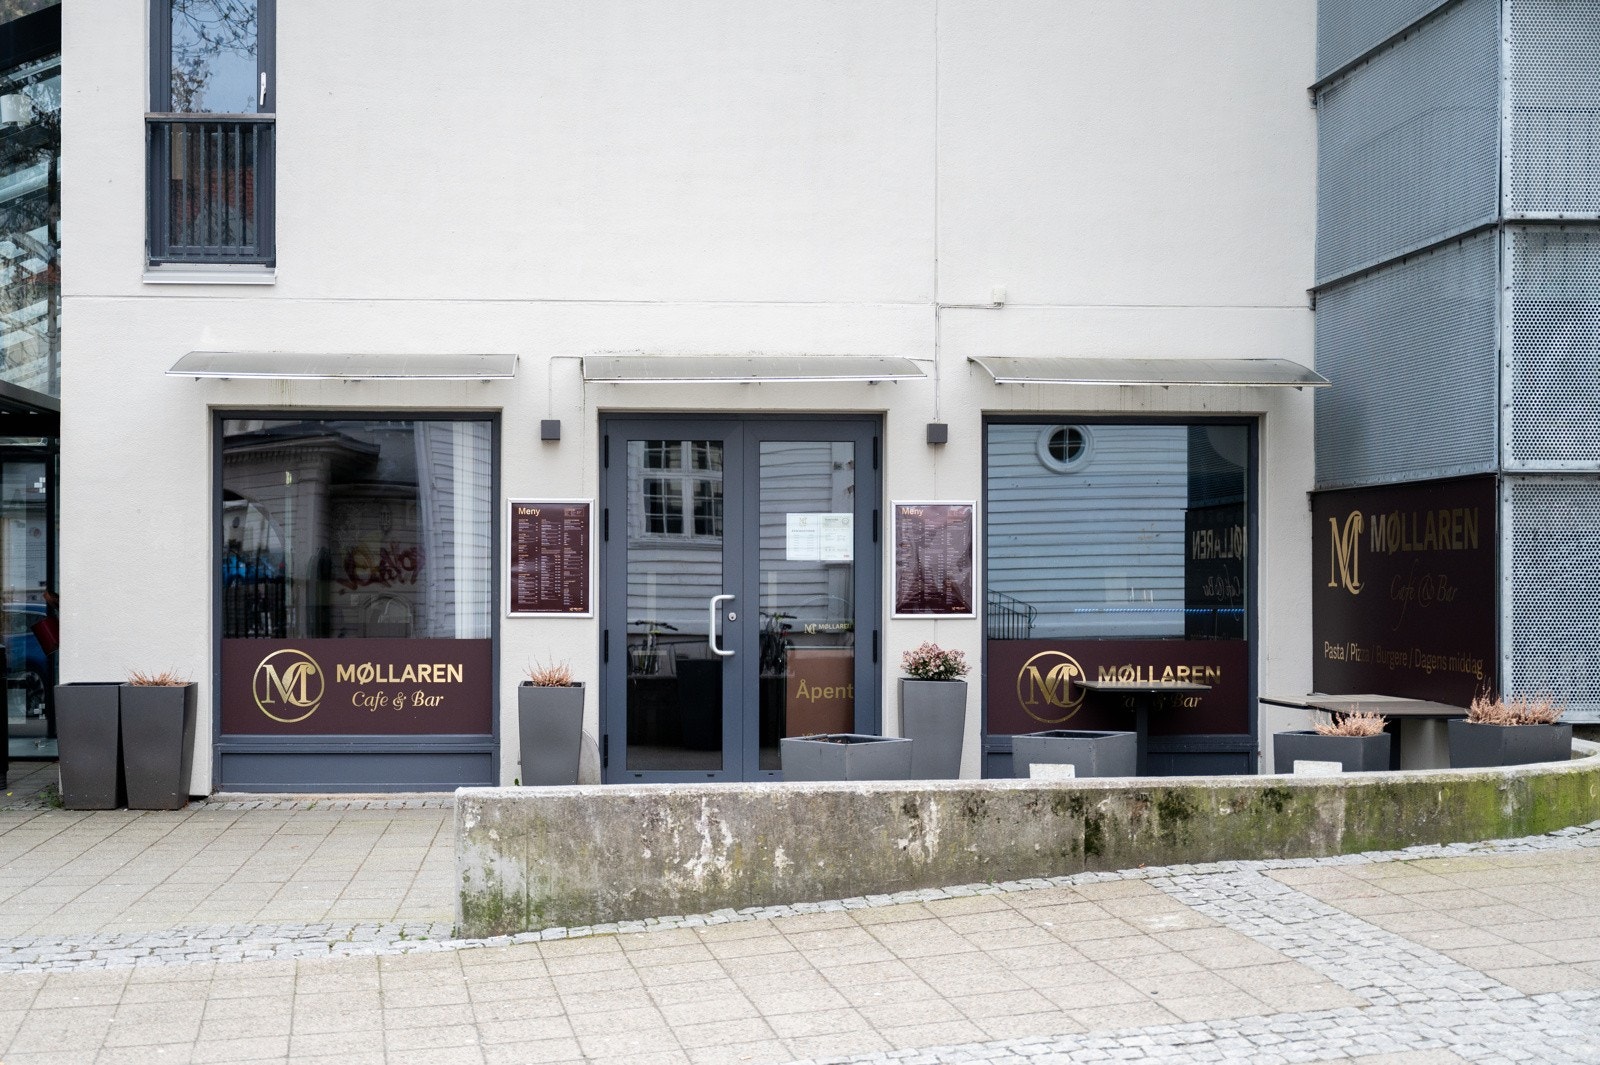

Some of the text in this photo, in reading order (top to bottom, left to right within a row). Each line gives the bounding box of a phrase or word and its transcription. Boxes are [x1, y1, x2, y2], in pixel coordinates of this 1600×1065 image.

[518, 507, 540, 516] Meny
[901, 507, 923, 516] Meny
[1371, 507, 1479, 555] MØLLAREN
[1324, 641, 1345, 660] Pasta
[1350, 643, 1370, 663] Pizza
[1376, 645, 1407, 670] Burgere
[1415, 649, 1447, 674] Dagens
[1449, 653, 1484, 680] middag
[336, 662, 463, 685] MØLLAREN
[1098, 664, 1221, 684] MØLLAREN
[352, 689, 444, 712] Cafe & Bar
[795, 679, 854, 703] Åpent
